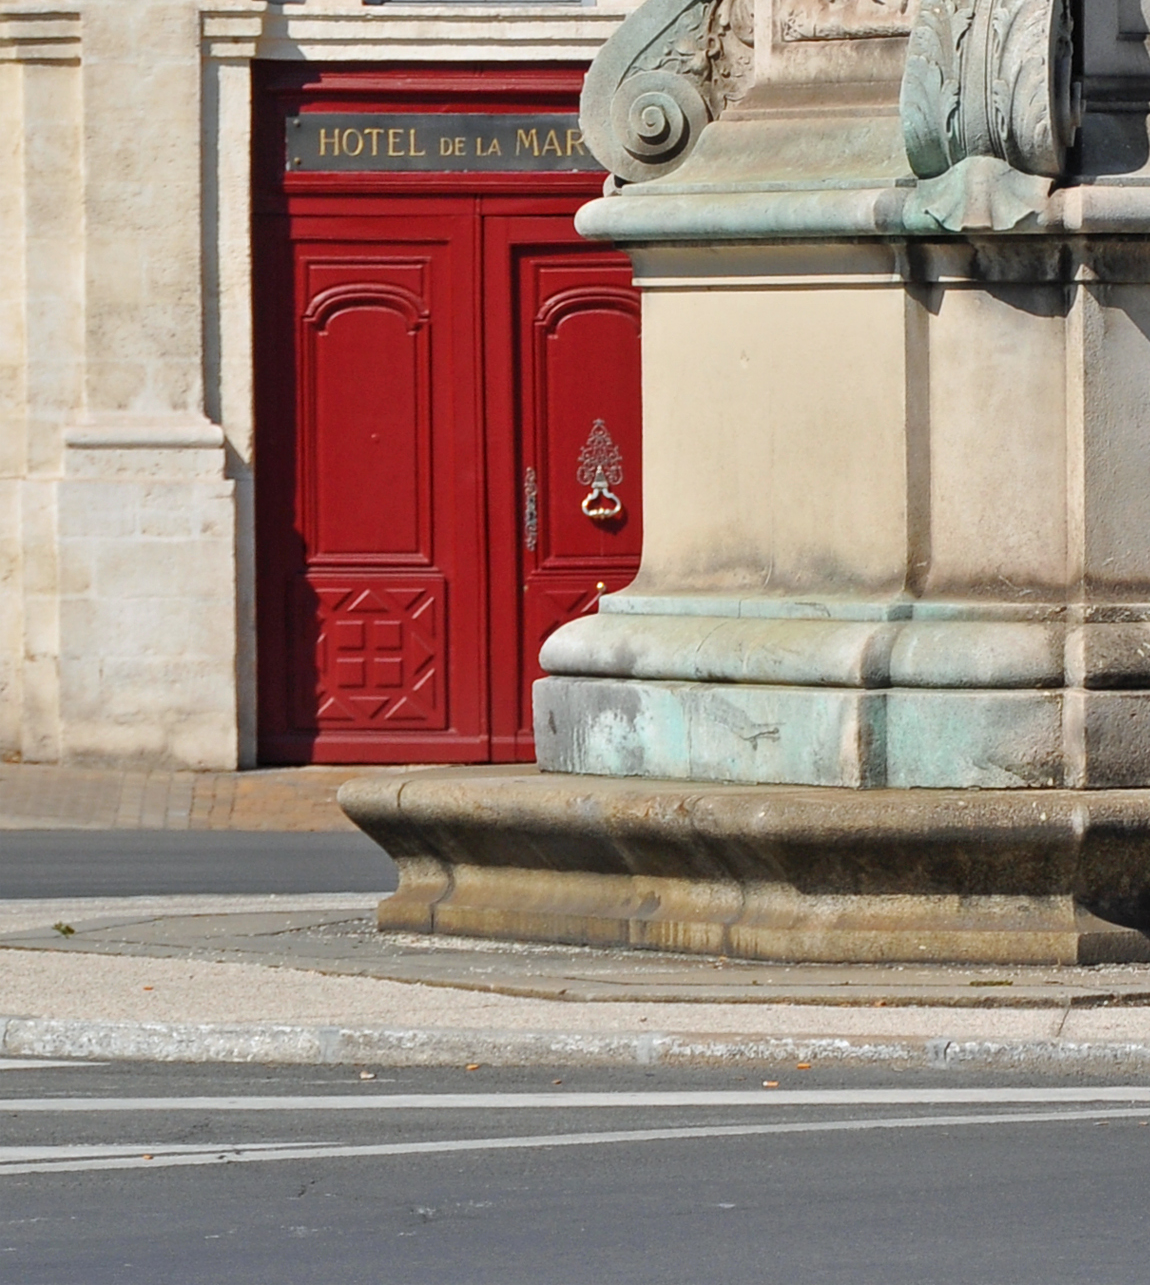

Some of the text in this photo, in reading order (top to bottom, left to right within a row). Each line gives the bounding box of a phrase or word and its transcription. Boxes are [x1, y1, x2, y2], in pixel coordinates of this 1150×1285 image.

[318, 128, 426, 157] HOTEL
[439, 137, 467, 157] DE
[475, 137, 502, 157] LA
